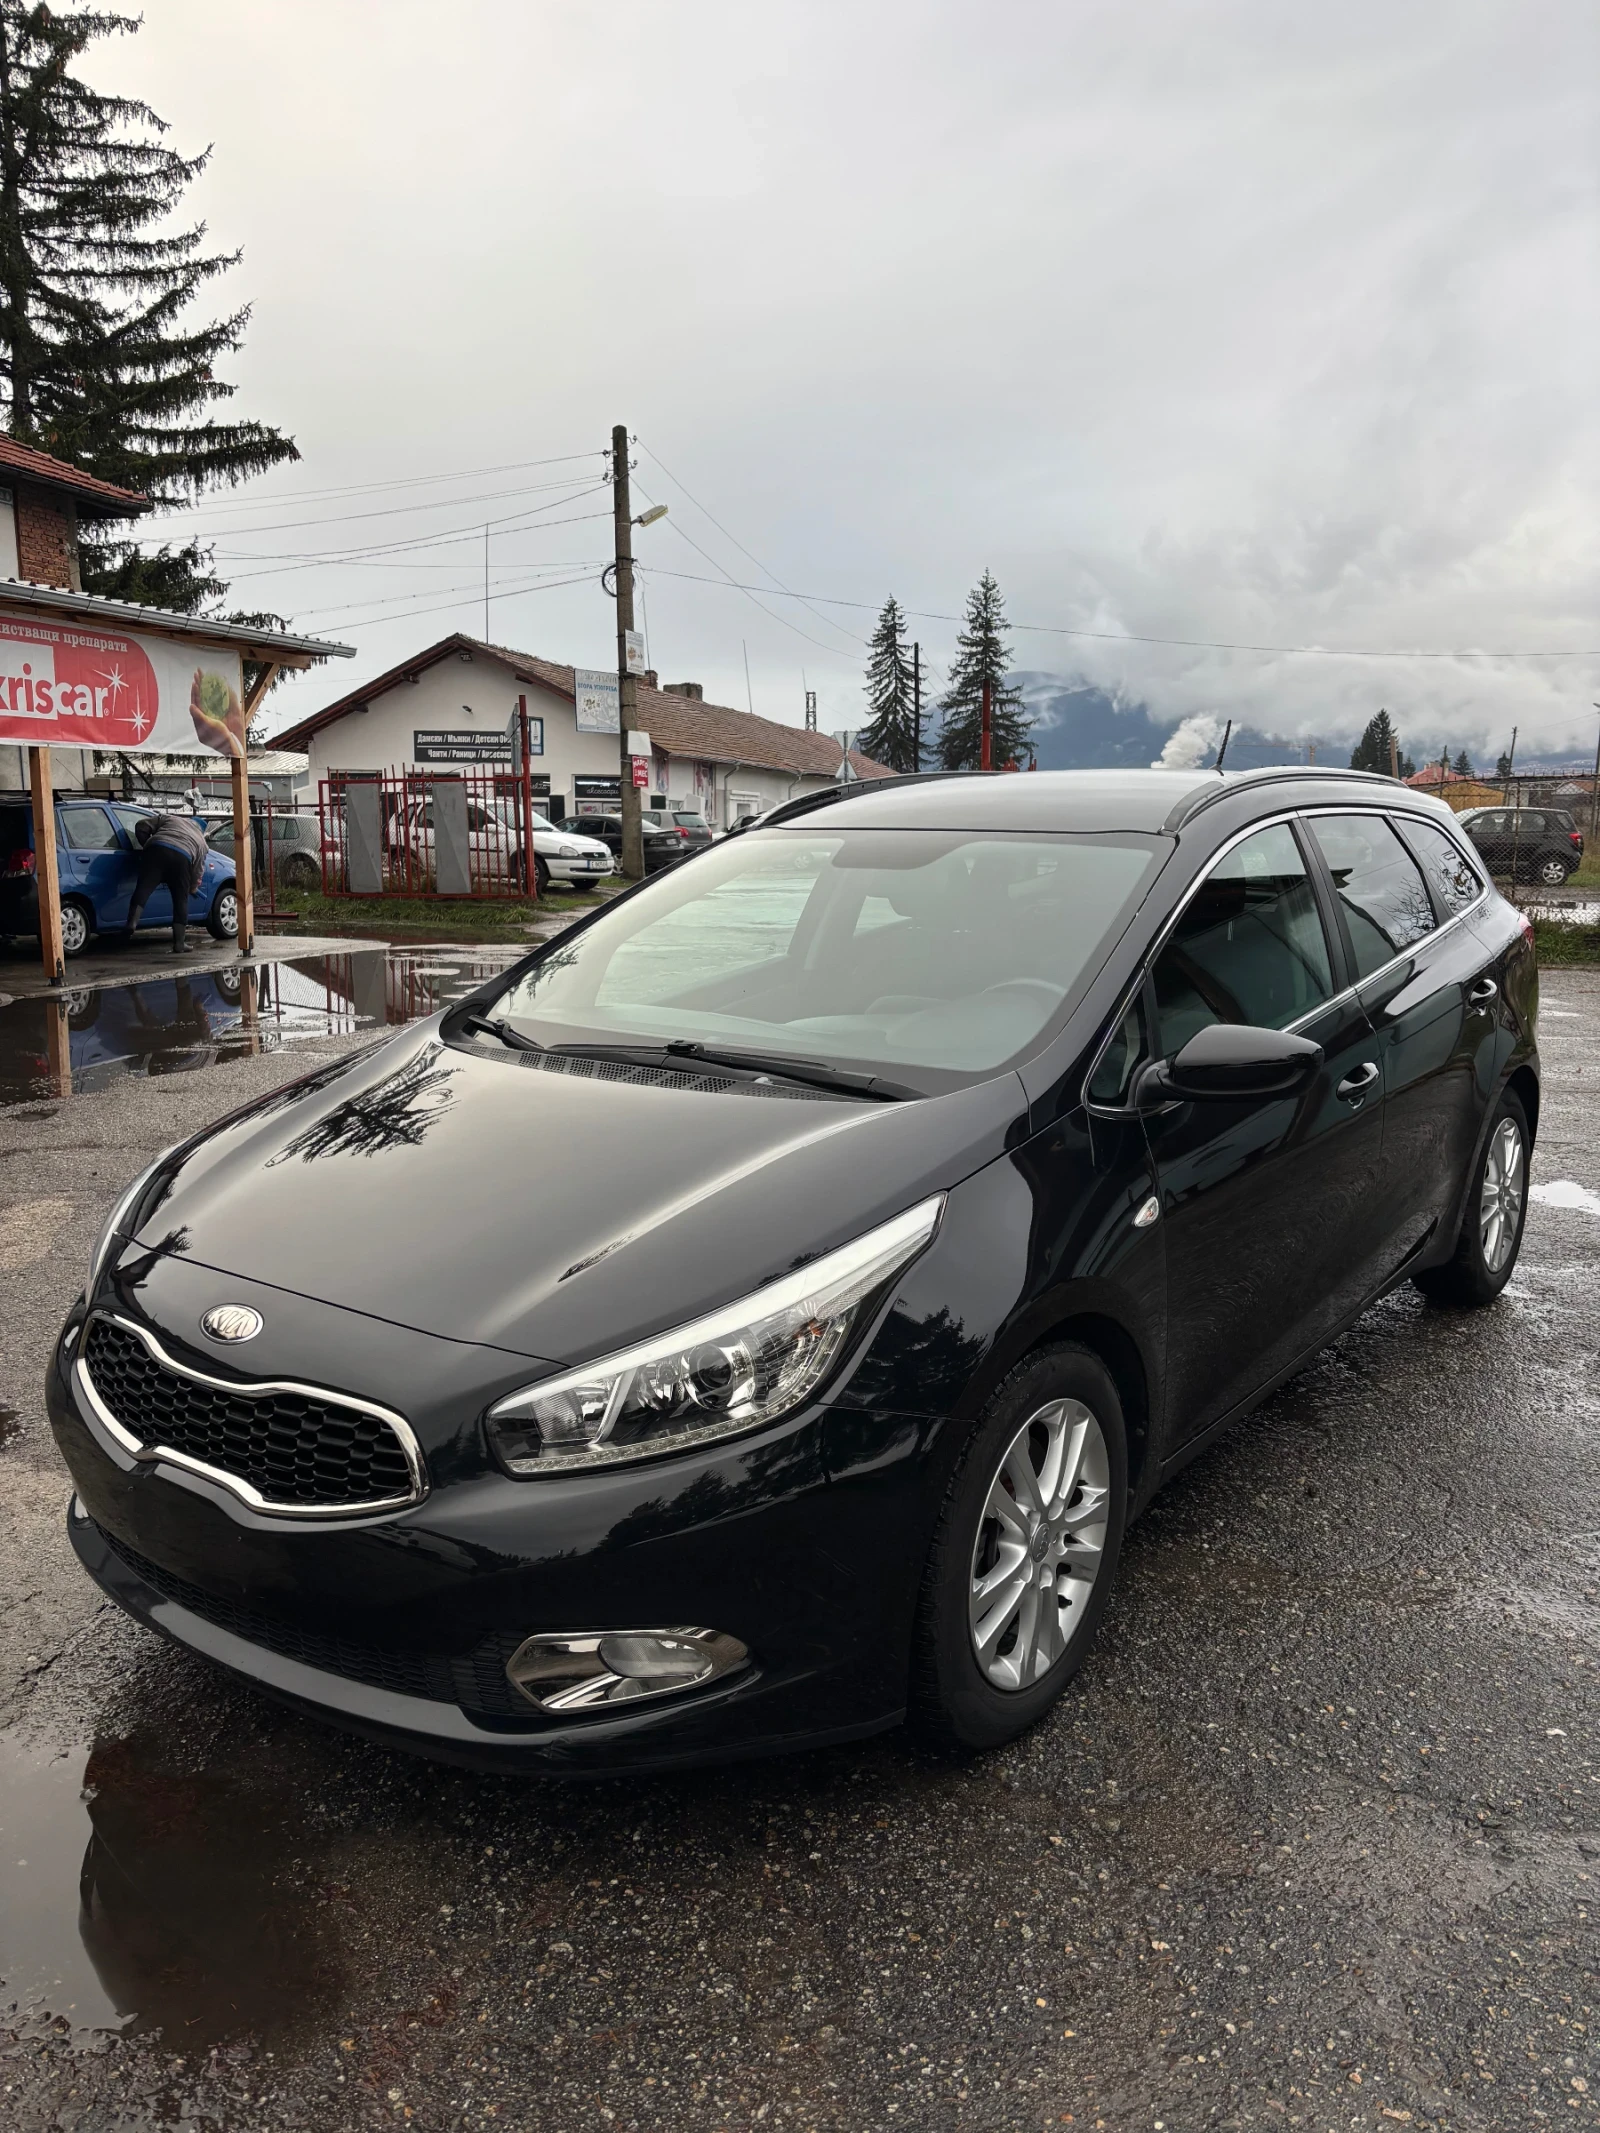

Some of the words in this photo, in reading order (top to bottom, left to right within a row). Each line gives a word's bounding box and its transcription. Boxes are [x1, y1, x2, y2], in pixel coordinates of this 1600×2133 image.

[0, 623, 60, 643] истващи
[63, 633, 128, 652] препарати
[475, 735, 499, 744] Детски
[428, 749, 448, 758] Чанти
[452, 750, 476, 759] Раници
[482, 750, 512, 760] Аксесоар
[206, 1310, 251, 1337] KIA
